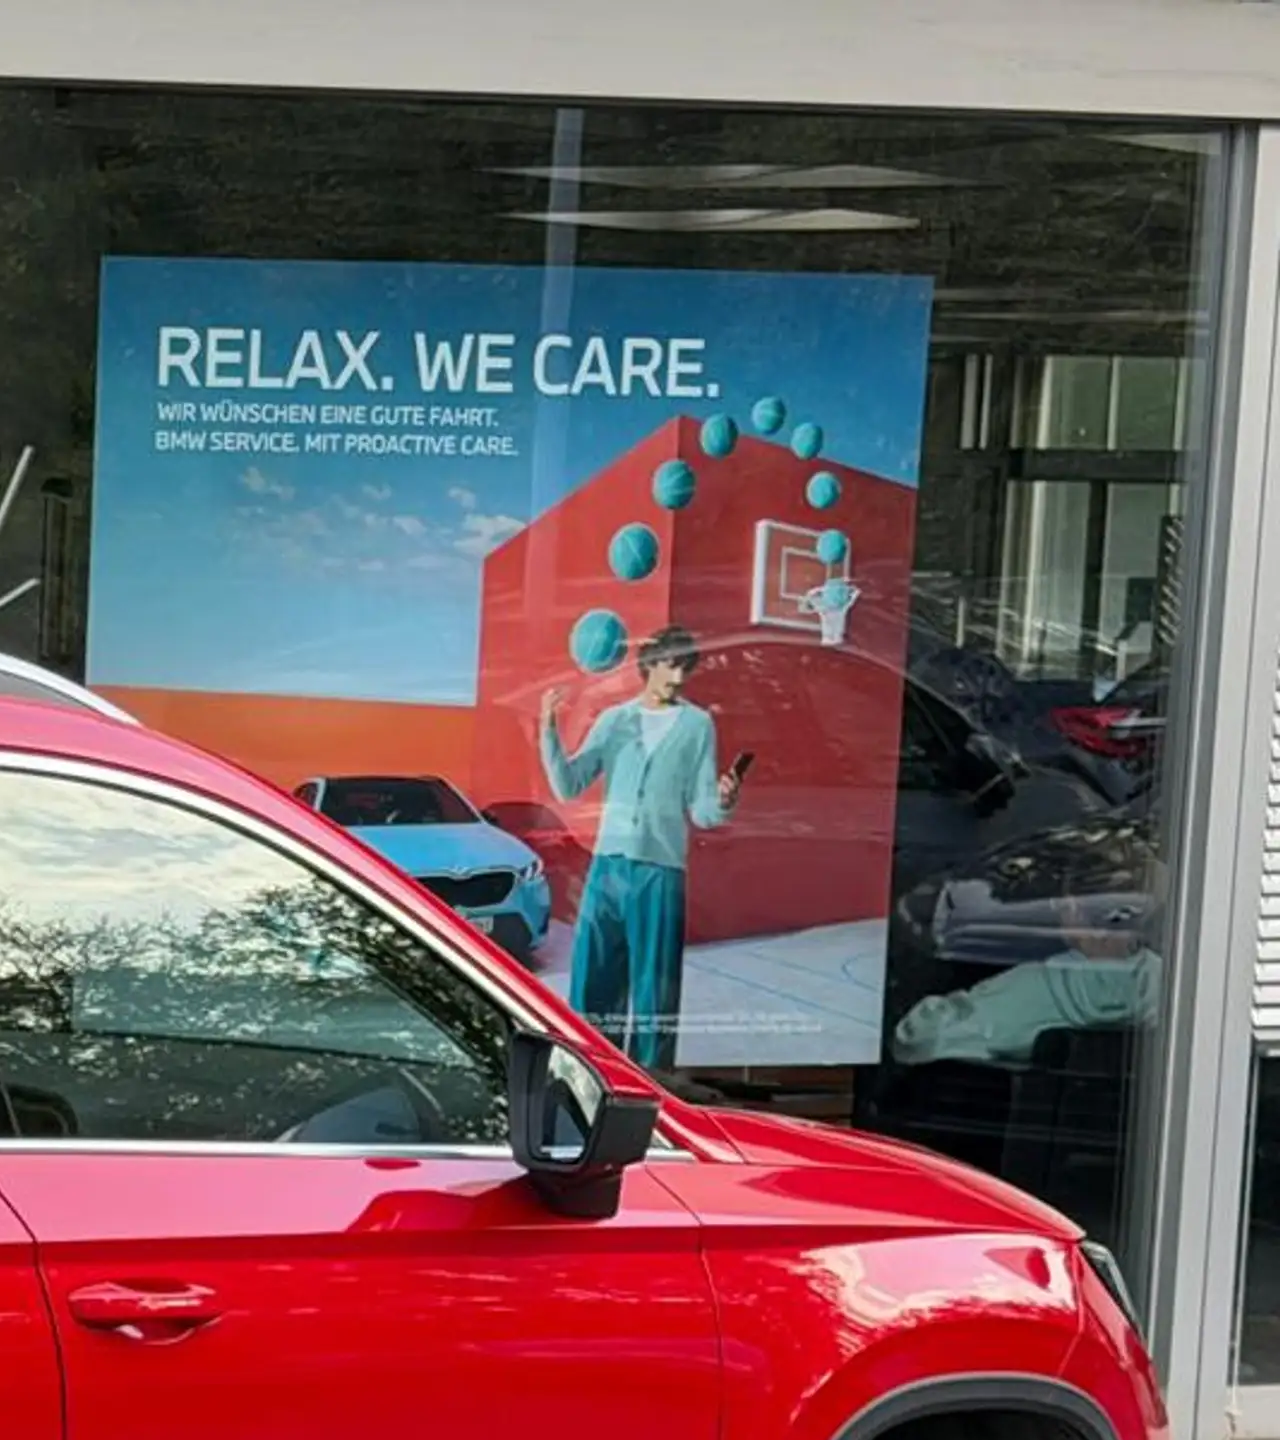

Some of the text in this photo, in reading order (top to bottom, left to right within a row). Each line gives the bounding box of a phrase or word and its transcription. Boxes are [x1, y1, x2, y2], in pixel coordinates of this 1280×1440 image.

[157, 326, 721, 398] RELAX. WE CARE.
[156, 399, 500, 428] WIR WÜNSCHEN EINE GUTE FAHRT.
[156, 431, 519, 456] BMW SERVICE. MIT PROACTIVE CARE.
